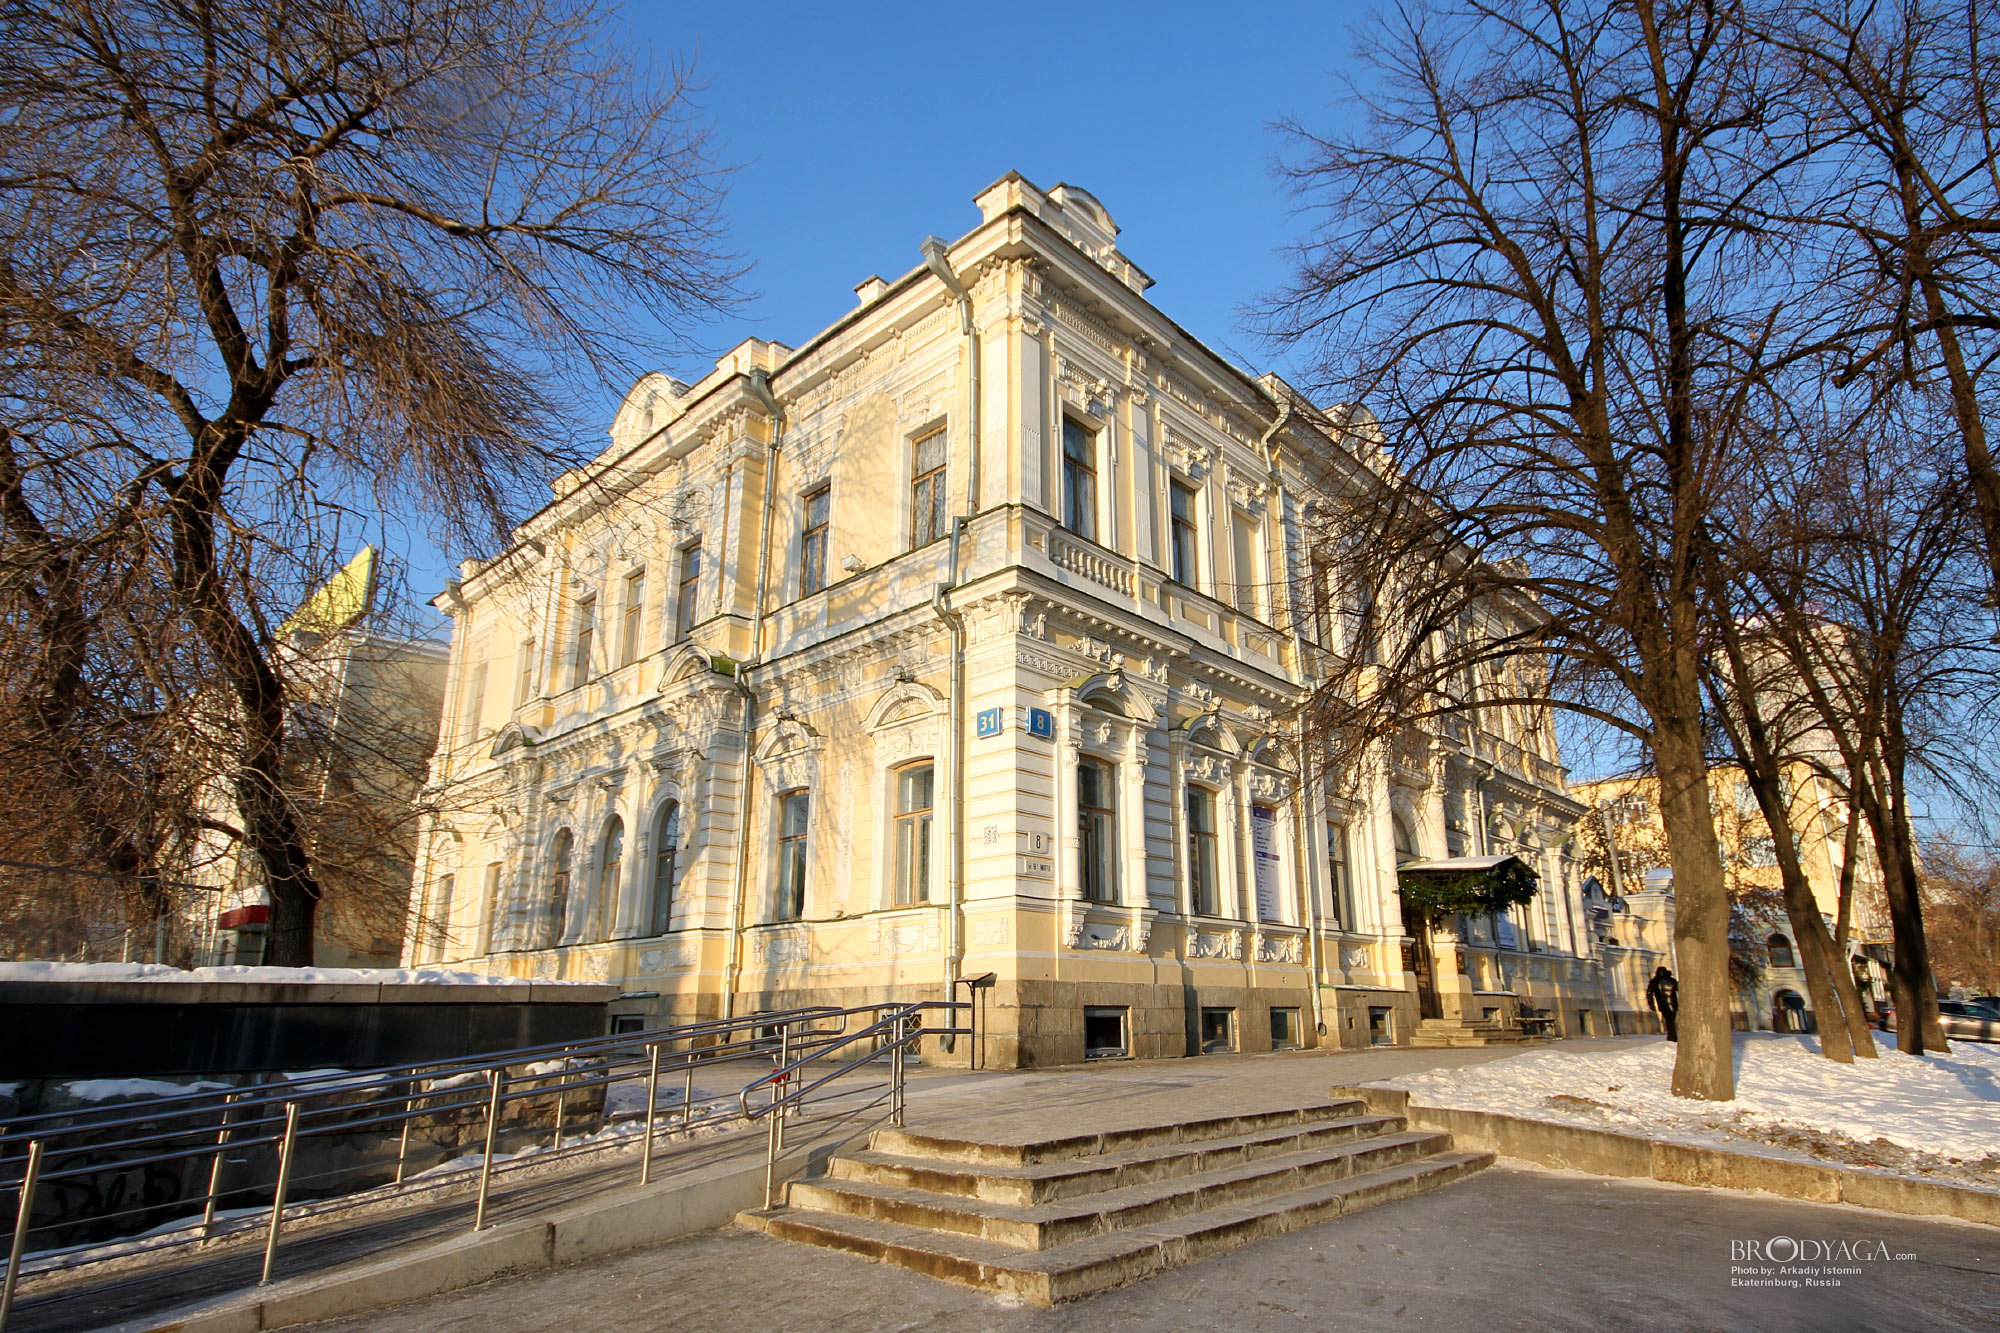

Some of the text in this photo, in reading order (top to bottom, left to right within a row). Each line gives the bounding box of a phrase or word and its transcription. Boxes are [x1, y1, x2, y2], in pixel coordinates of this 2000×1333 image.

[980, 713, 995, 732] 31
[1037, 714, 1045, 730] 8
[1035, 834, 1041, 849] 8
